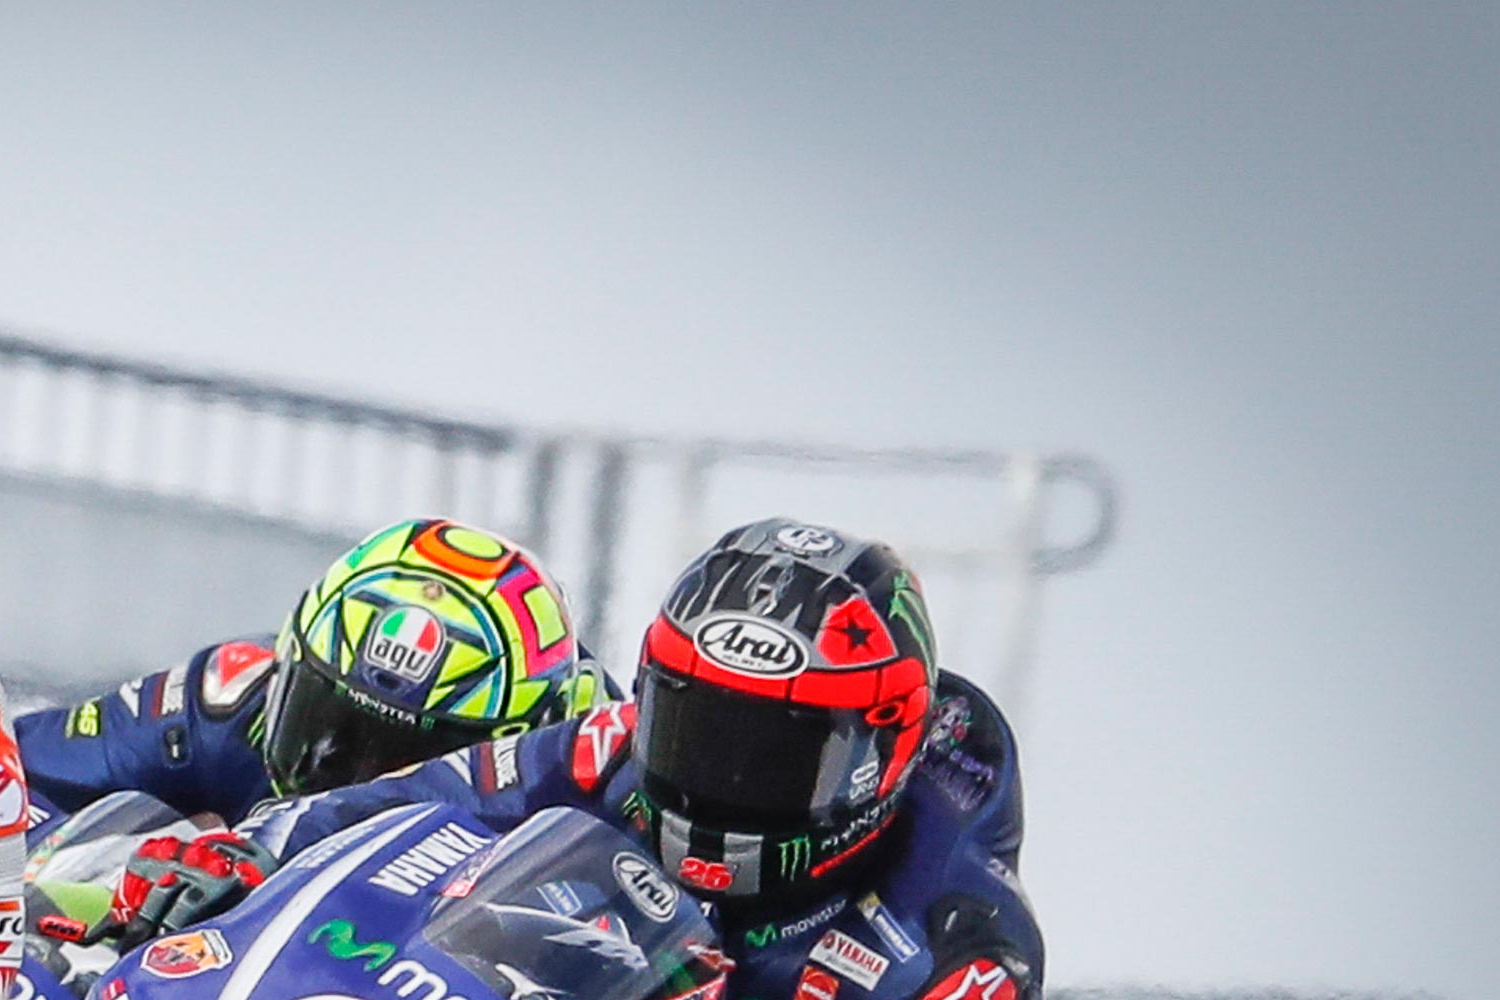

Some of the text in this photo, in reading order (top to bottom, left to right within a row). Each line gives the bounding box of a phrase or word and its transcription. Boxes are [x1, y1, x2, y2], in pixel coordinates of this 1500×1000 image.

[374, 637, 428, 672] agv
[701, 622, 792, 666] Arai
[368, 821, 493, 897] YAMAHA
[678, 856, 733, 891] 25
[619, 866, 674, 911] Arai
[780, 898, 848, 939] movistar
[834, 934, 884, 974] YAMAHA
